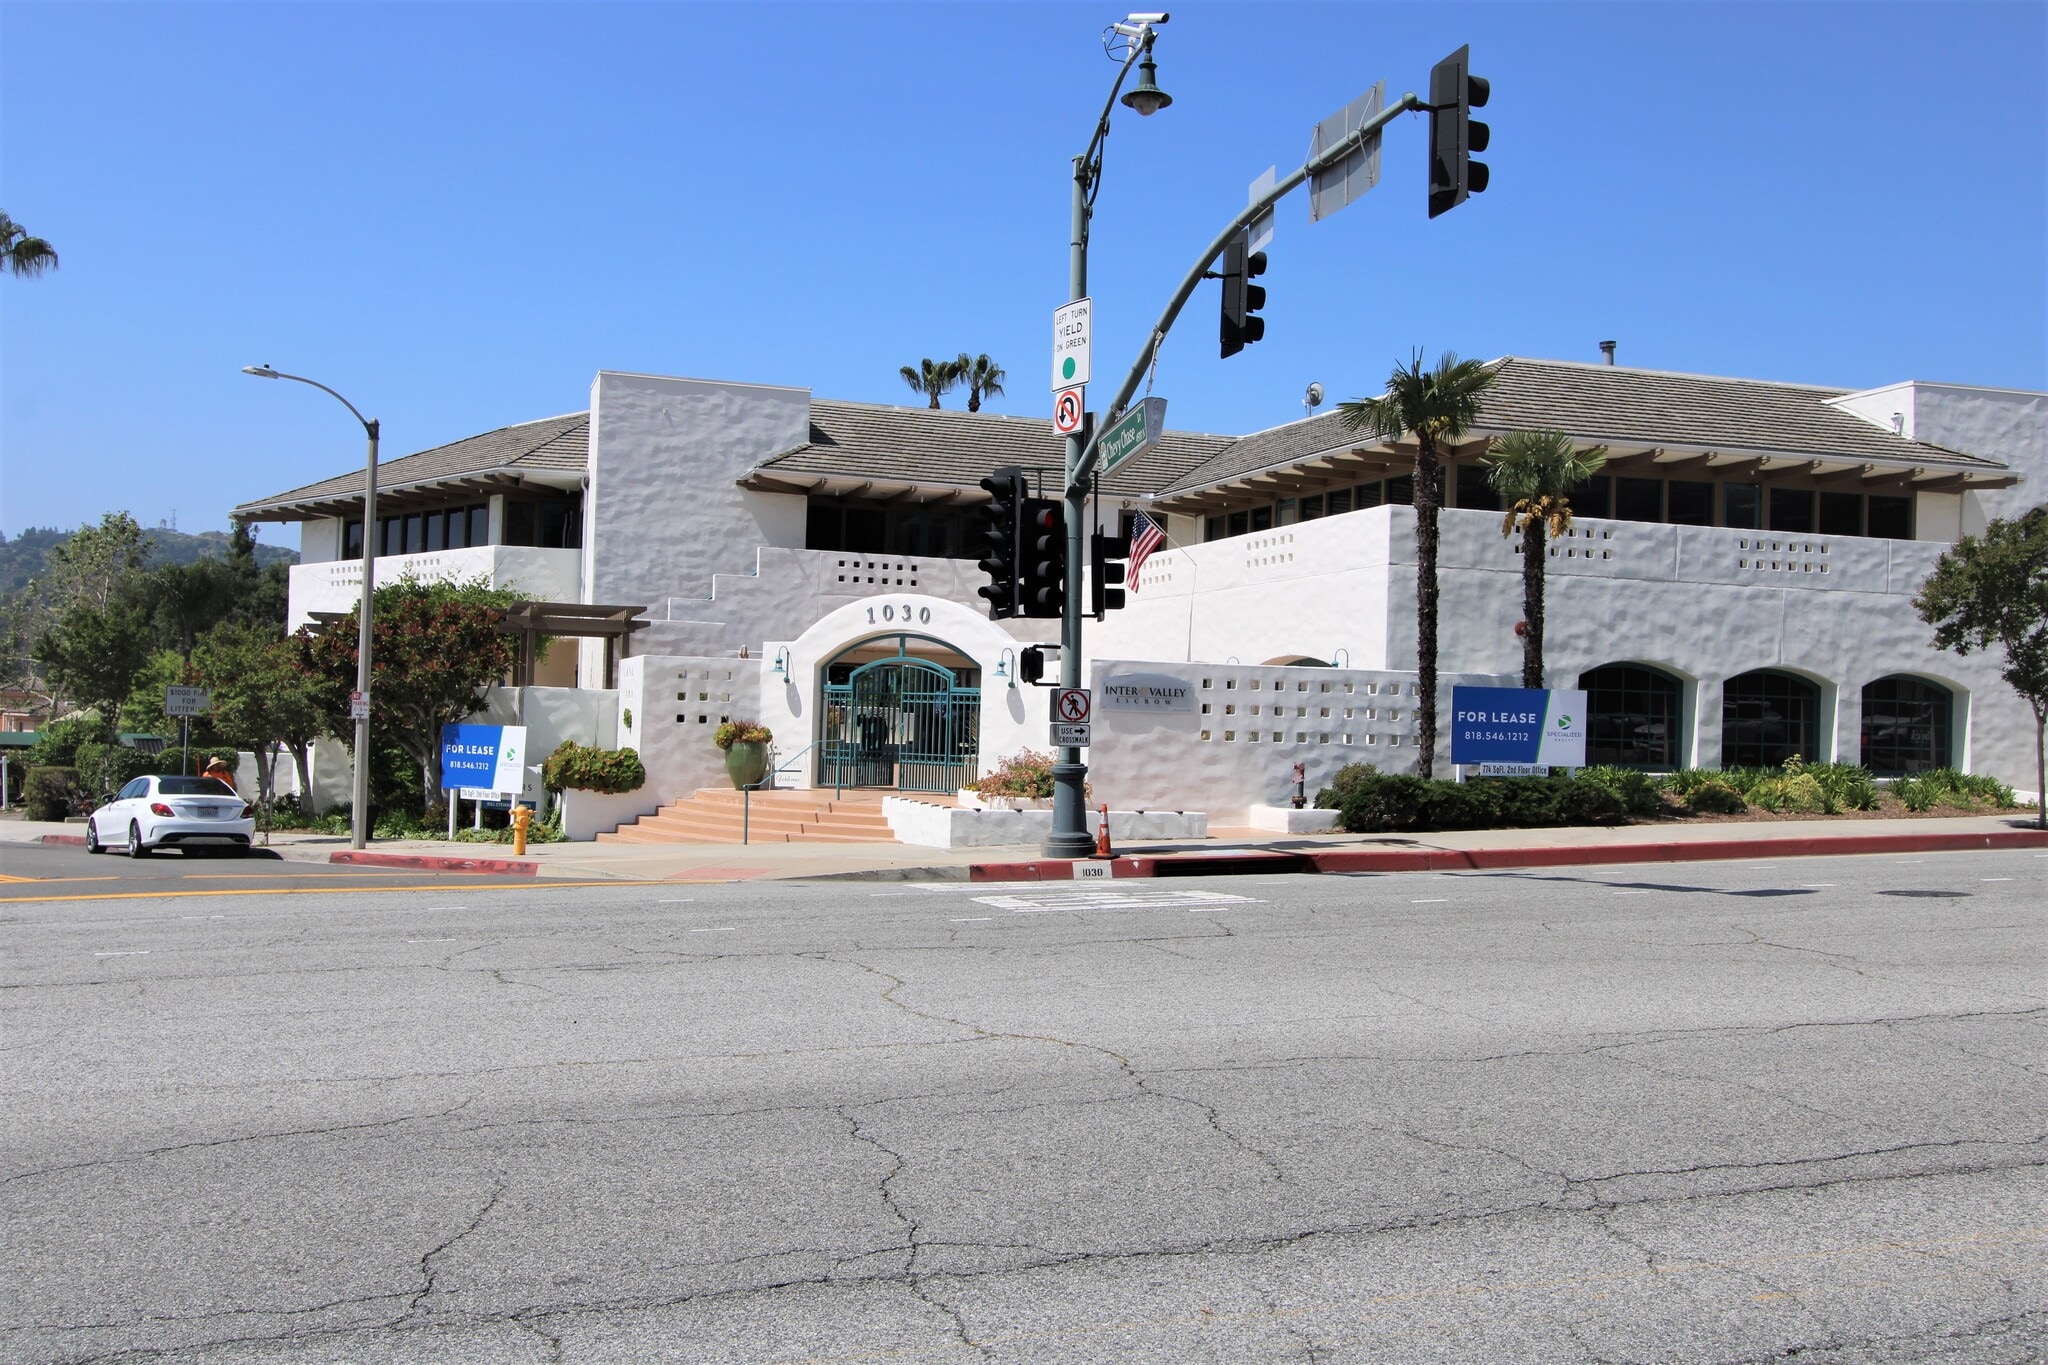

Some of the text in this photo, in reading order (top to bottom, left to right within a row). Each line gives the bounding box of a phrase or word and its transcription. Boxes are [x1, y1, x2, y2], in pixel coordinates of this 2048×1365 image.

[1056, 307, 1088, 325] LEFT TURN
[1059, 322, 1083, 338] YIELD
[1056, 336, 1087, 352] ON GREEN
[1107, 427, 1136, 460] Chevy Chase
[867, 604, 931, 625] 1030
[1105, 686, 1186, 697] INTER VALLEY
[1458, 711, 1536, 724] FOR LEASE
[1060, 727, 1073, 735] USE
[1464, 731, 1529, 741] 818.546.1212
[1058, 736, 1088, 744] CROSSWALK
[446, 744, 494, 755] FOR LEASE
[450, 760, 489, 770] 818.546.1212
[1482, 765, 1491, 773] 774
[1507, 765, 1516, 774] 2nd
[1518, 765, 1531, 774] Floor
[1532, 765, 1547, 775] Office
[1082, 868, 1103, 877] 1030
